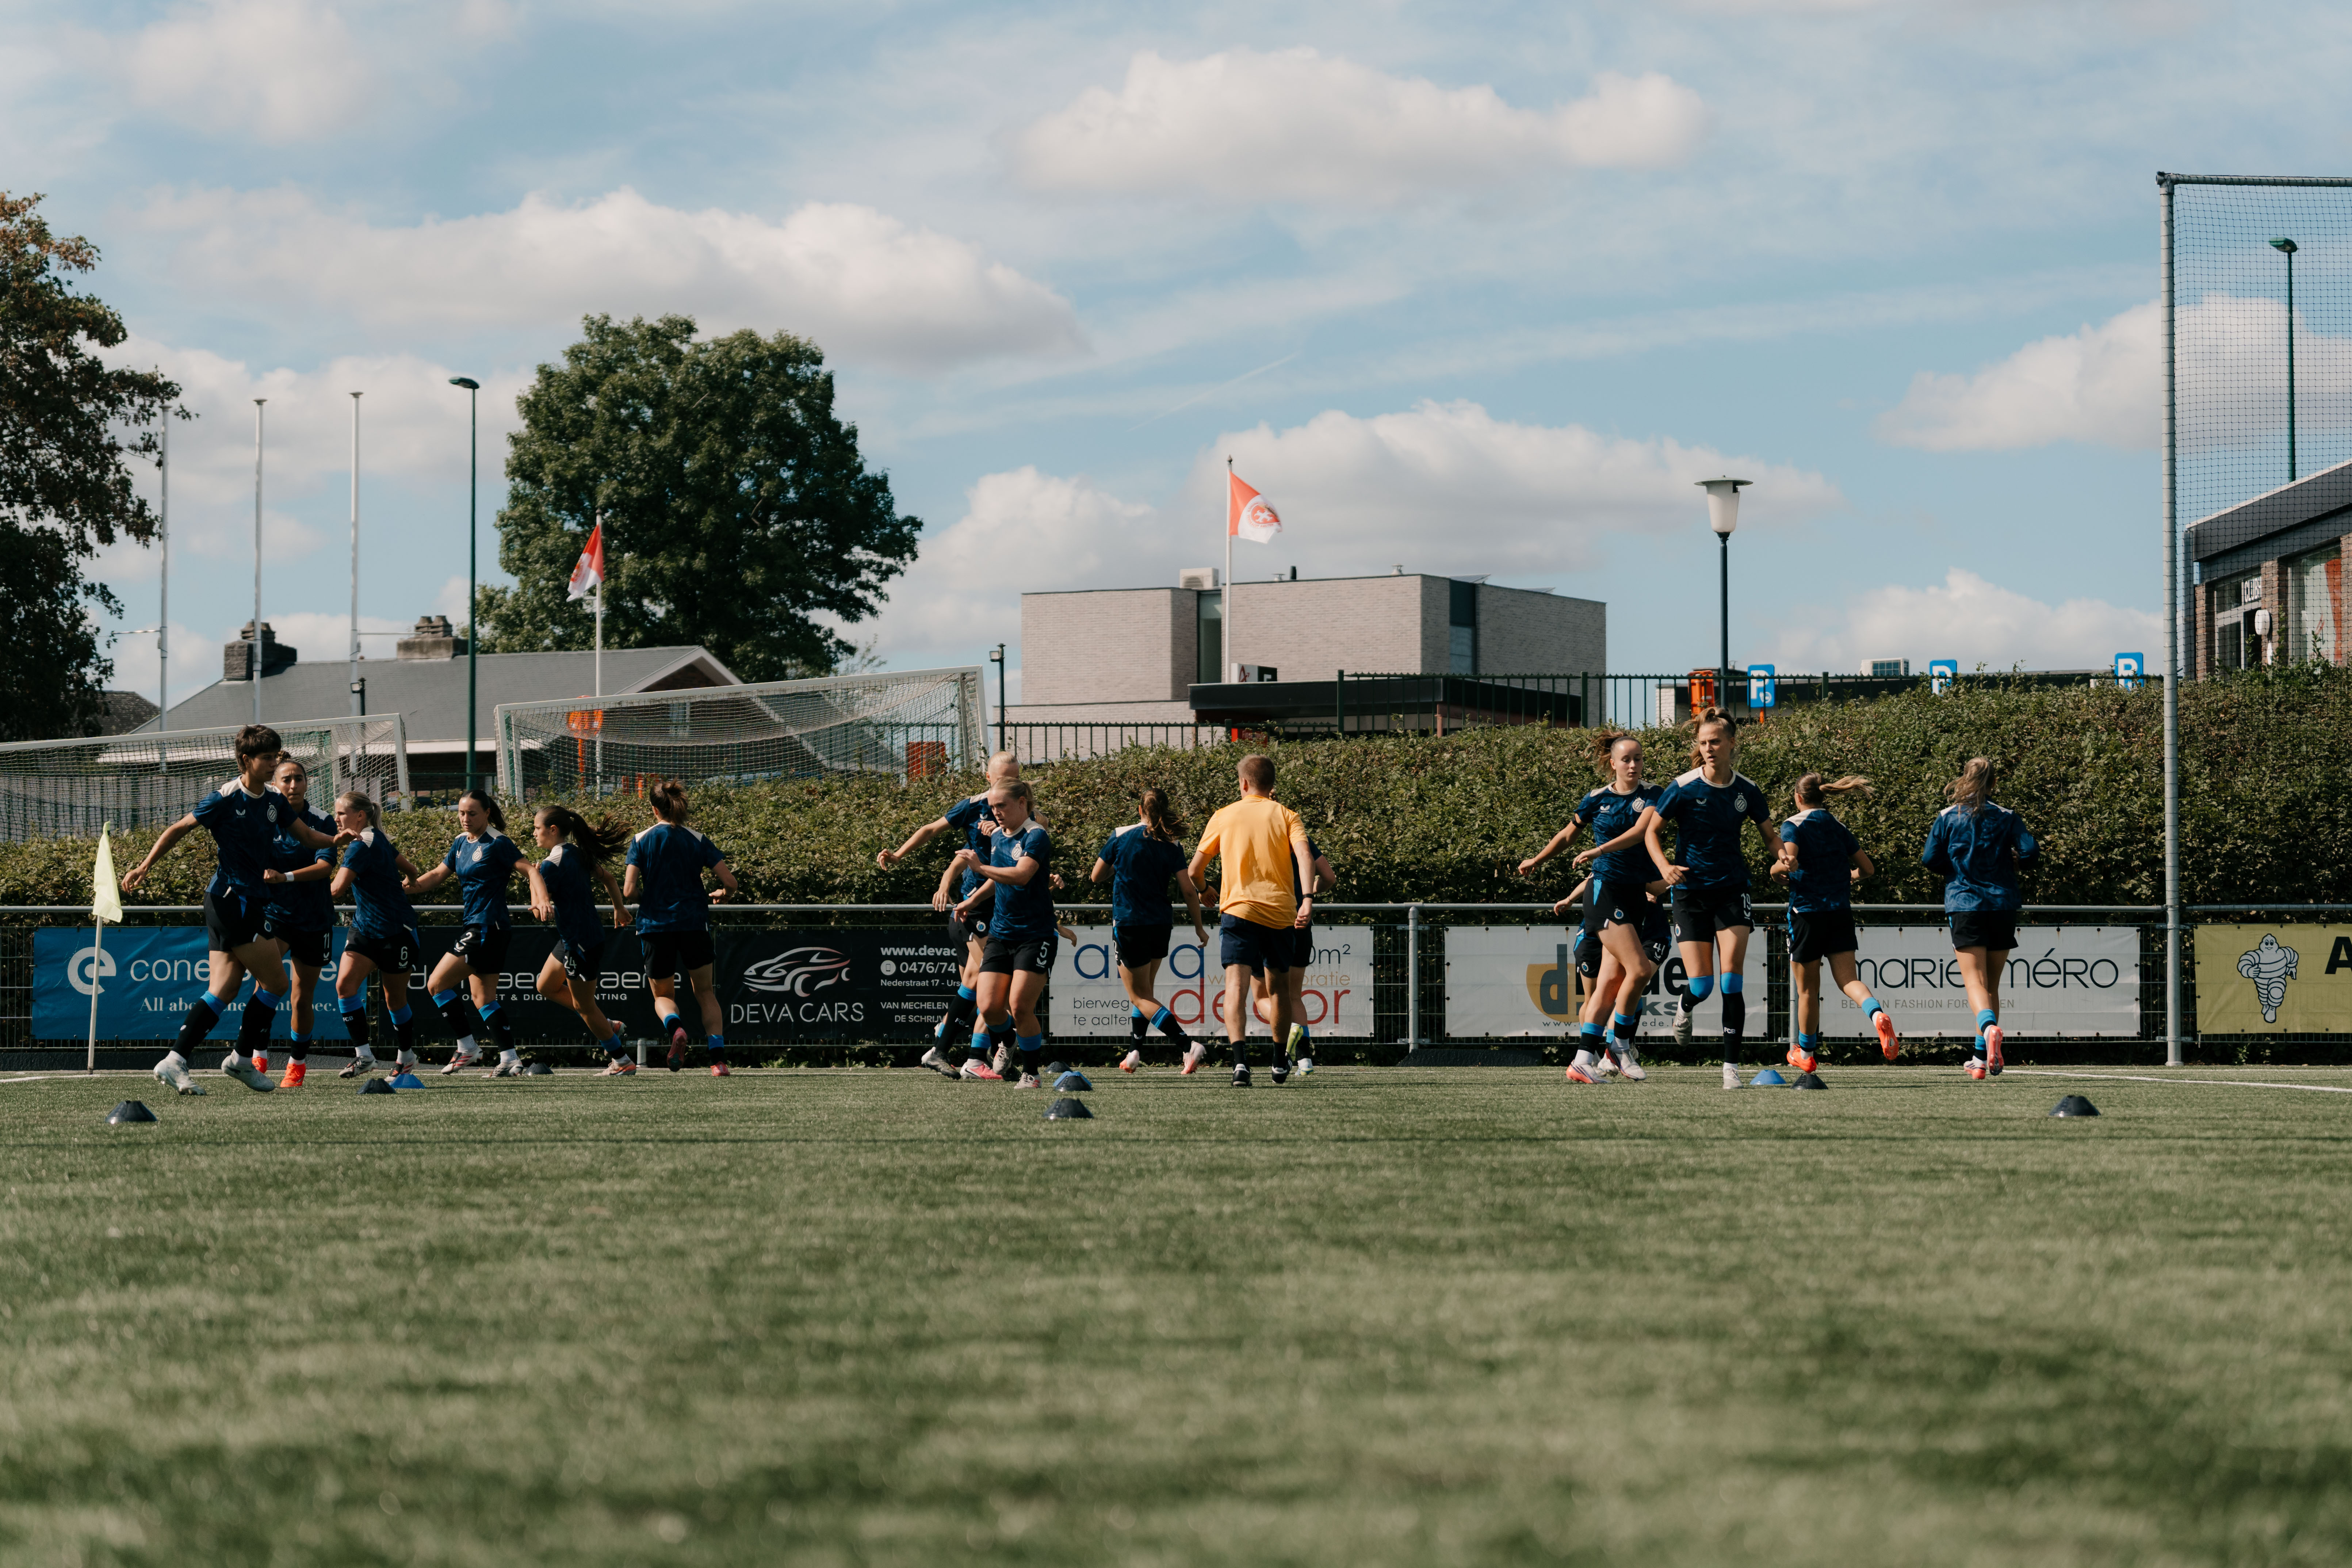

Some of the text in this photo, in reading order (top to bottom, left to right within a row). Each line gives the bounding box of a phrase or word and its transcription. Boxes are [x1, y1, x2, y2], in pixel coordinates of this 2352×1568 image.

[1751, 670, 1770, 699] P
[459, 932, 472, 945] 2
[401, 946, 408, 960] 6
[880, 945, 957, 956] www.devac
[1040, 941, 1050, 958] 5
[564, 955, 577, 968] 24
[900, 961, 956, 973] 0476/74
[139, 997, 164, 1011] All
[1074, 997, 1129, 1011] bierweg
[1895, 999, 1942, 1008] FASHION
[1947, 999, 1968, 1008] FOR
[731, 1002, 864, 1023] DEVA CARS
[1073, 1014, 1086, 1025] te
